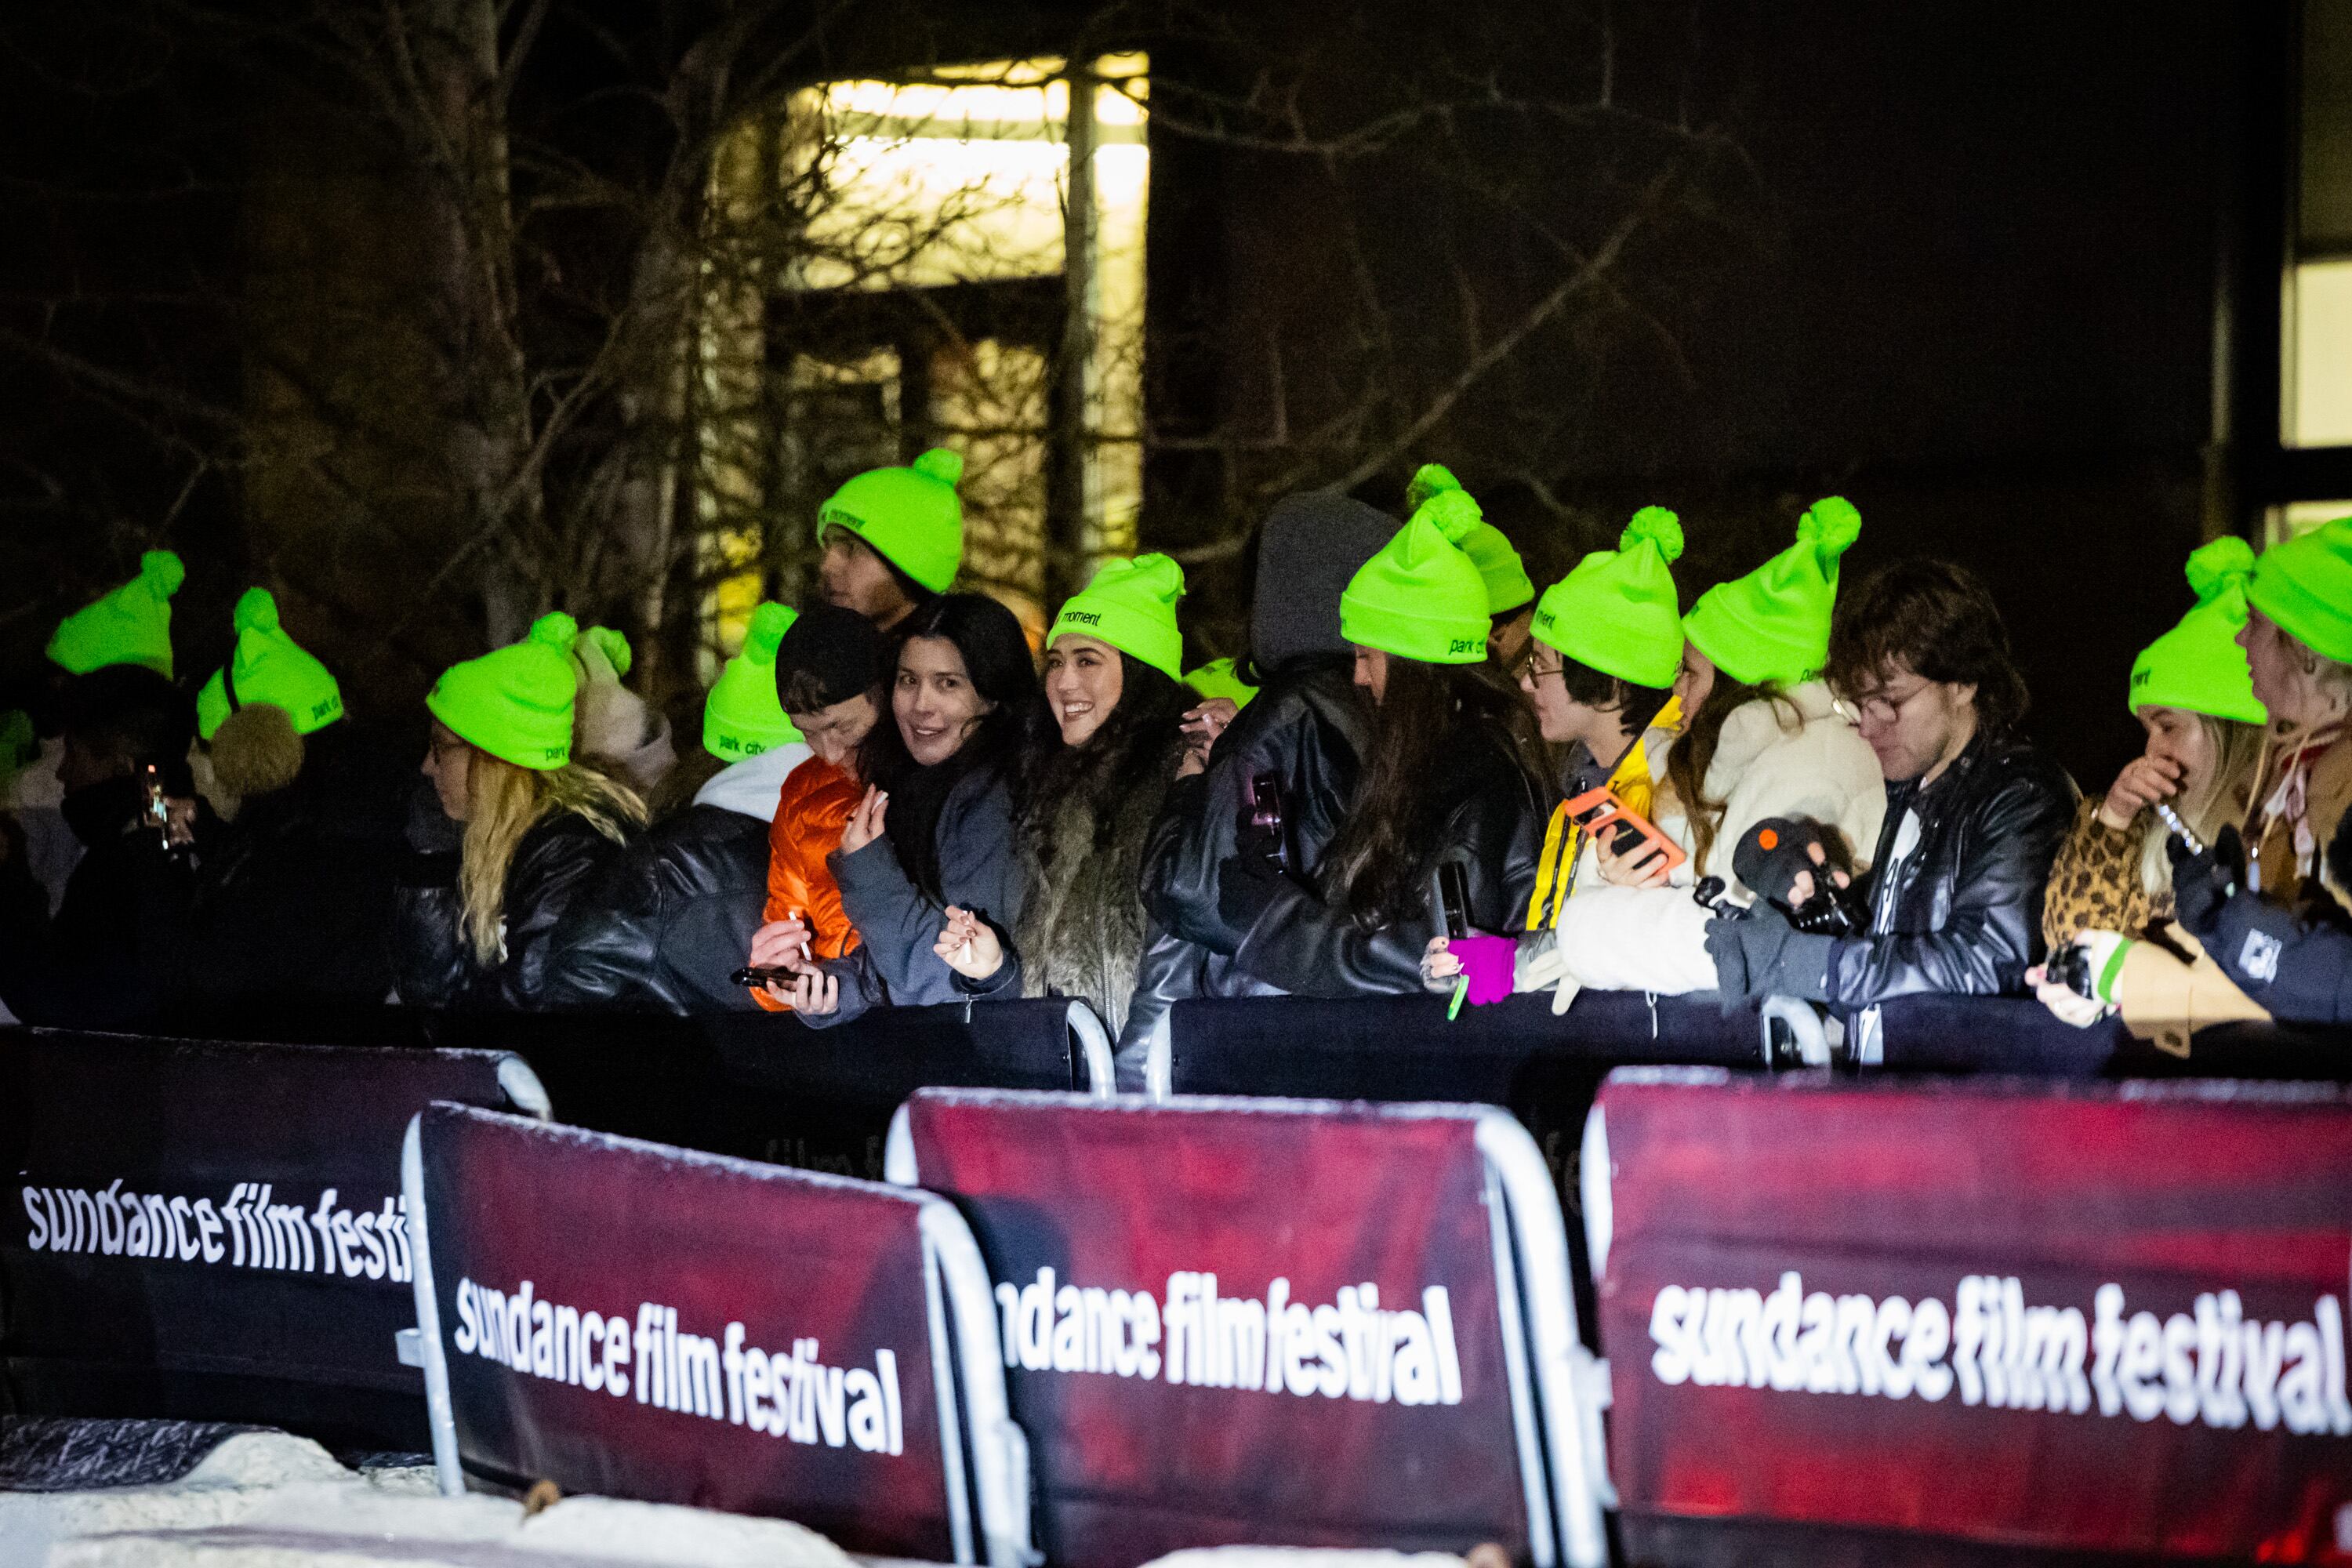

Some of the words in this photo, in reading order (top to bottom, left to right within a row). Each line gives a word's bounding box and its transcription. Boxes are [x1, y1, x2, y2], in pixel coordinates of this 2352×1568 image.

[1063, 612, 1102, 626] moment
[22, 1178, 225, 1263] sundance
[220, 1182, 315, 1272] film
[310, 1188, 413, 1283] festi
[455, 1277, 630, 1397] sundance
[632, 1301, 724, 1421] film
[722, 1321, 904, 1457] festival
[994, 1265, 1162, 1381] ndance
[1162, 1270, 1267, 1392] film
[1648, 1270, 1953, 1402] sundance
[1952, 1275, 2092, 1412] film
[2091, 1283, 2352, 1437] festival
